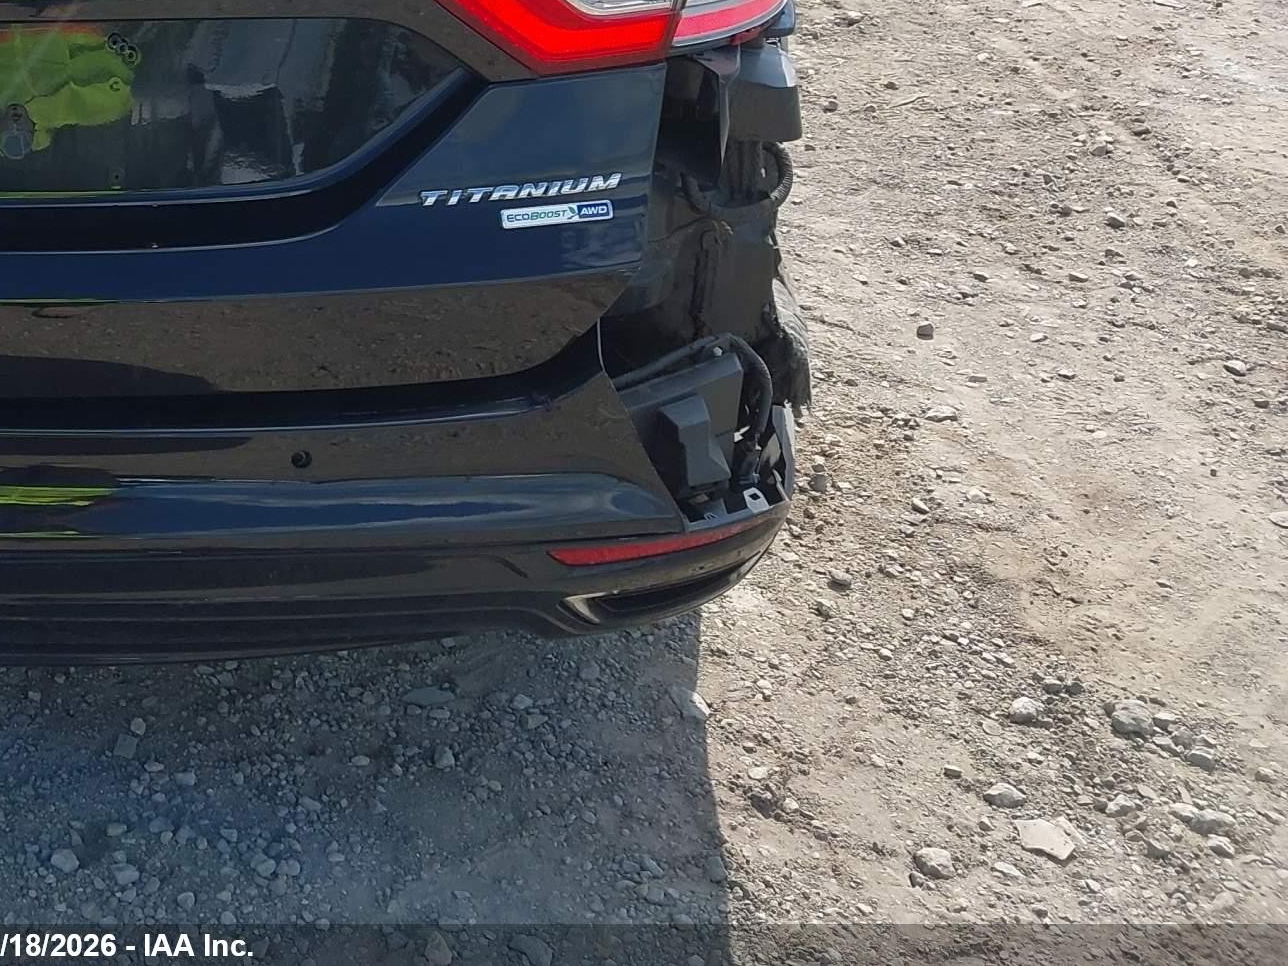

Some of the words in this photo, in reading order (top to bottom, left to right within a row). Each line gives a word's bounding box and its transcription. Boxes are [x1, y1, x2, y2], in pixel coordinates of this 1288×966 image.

[421, 172, 623, 206] TITANIUM
[506, 208, 569, 223] ECOBOOST
[579, 205, 608, 218] AWD
